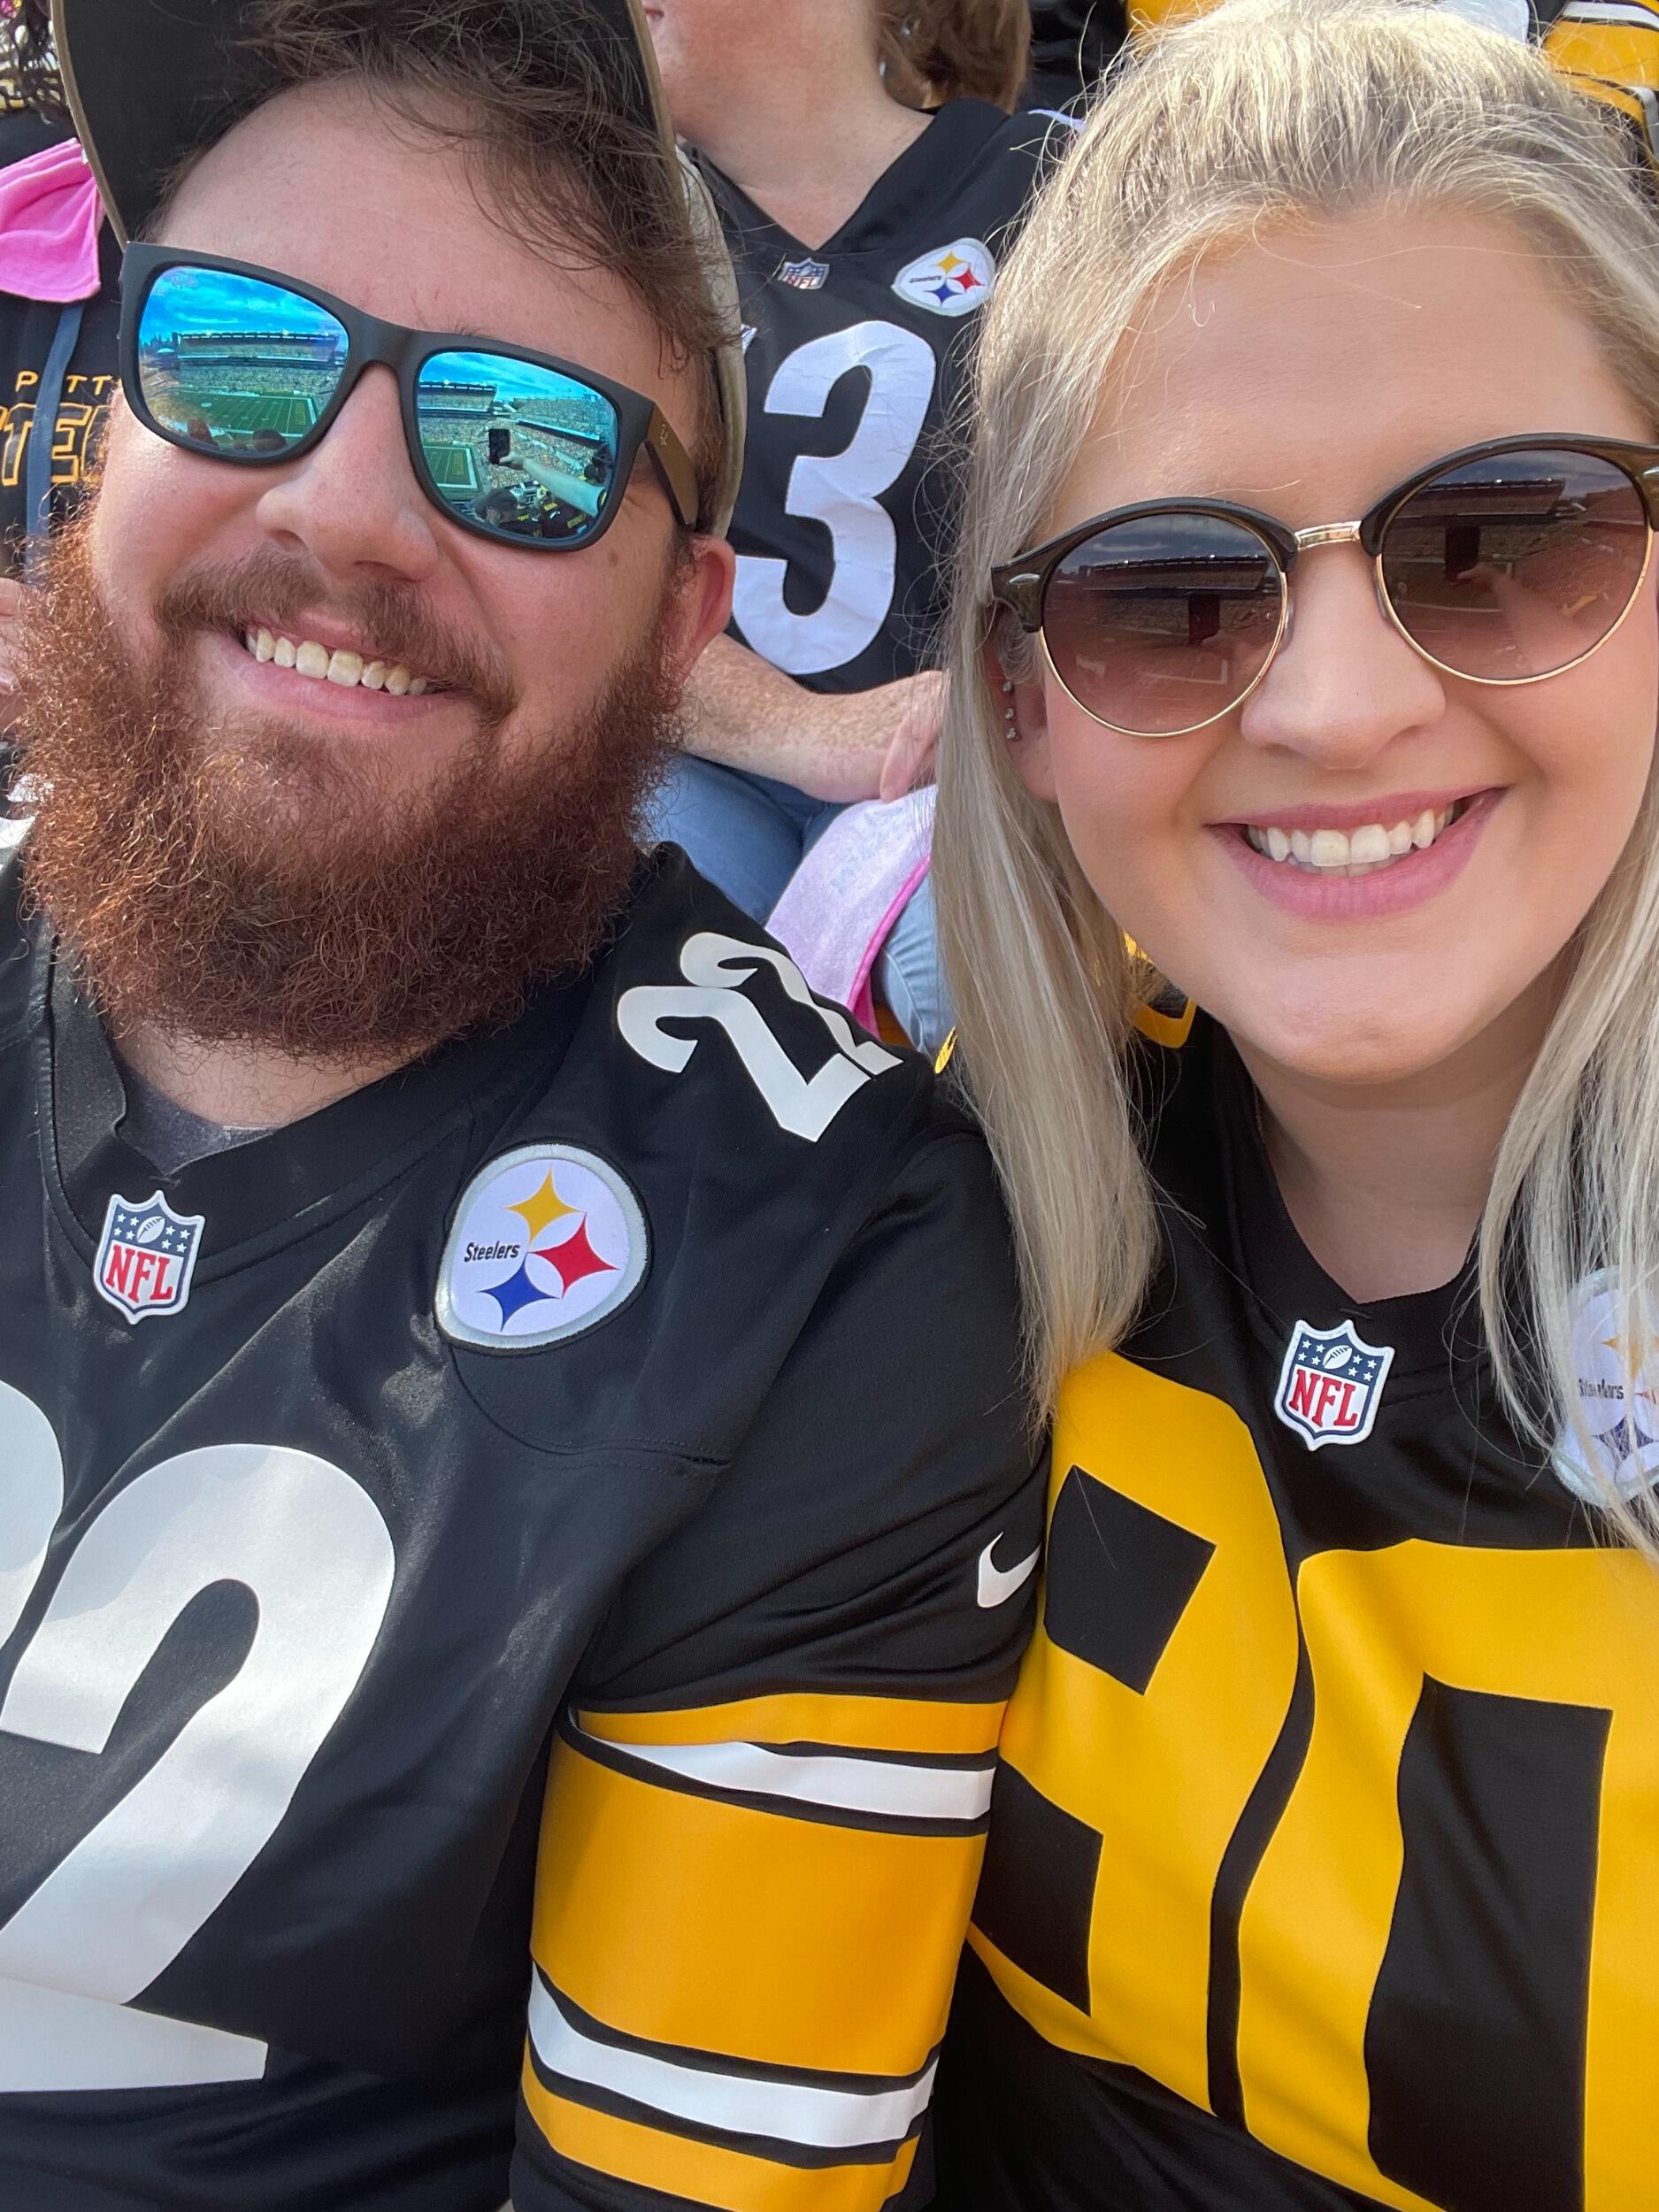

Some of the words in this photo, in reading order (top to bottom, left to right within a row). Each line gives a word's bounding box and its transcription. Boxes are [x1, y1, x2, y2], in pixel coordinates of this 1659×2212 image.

[15, 371, 112, 396] PTT
[618, 932, 904, 1142] 22
[105, 1244, 173, 1303] NFL
[465, 1240, 521, 1263] Steelers
[1288, 1369, 1357, 1427] NFL
[0, 1380, 395, 2093] 2
